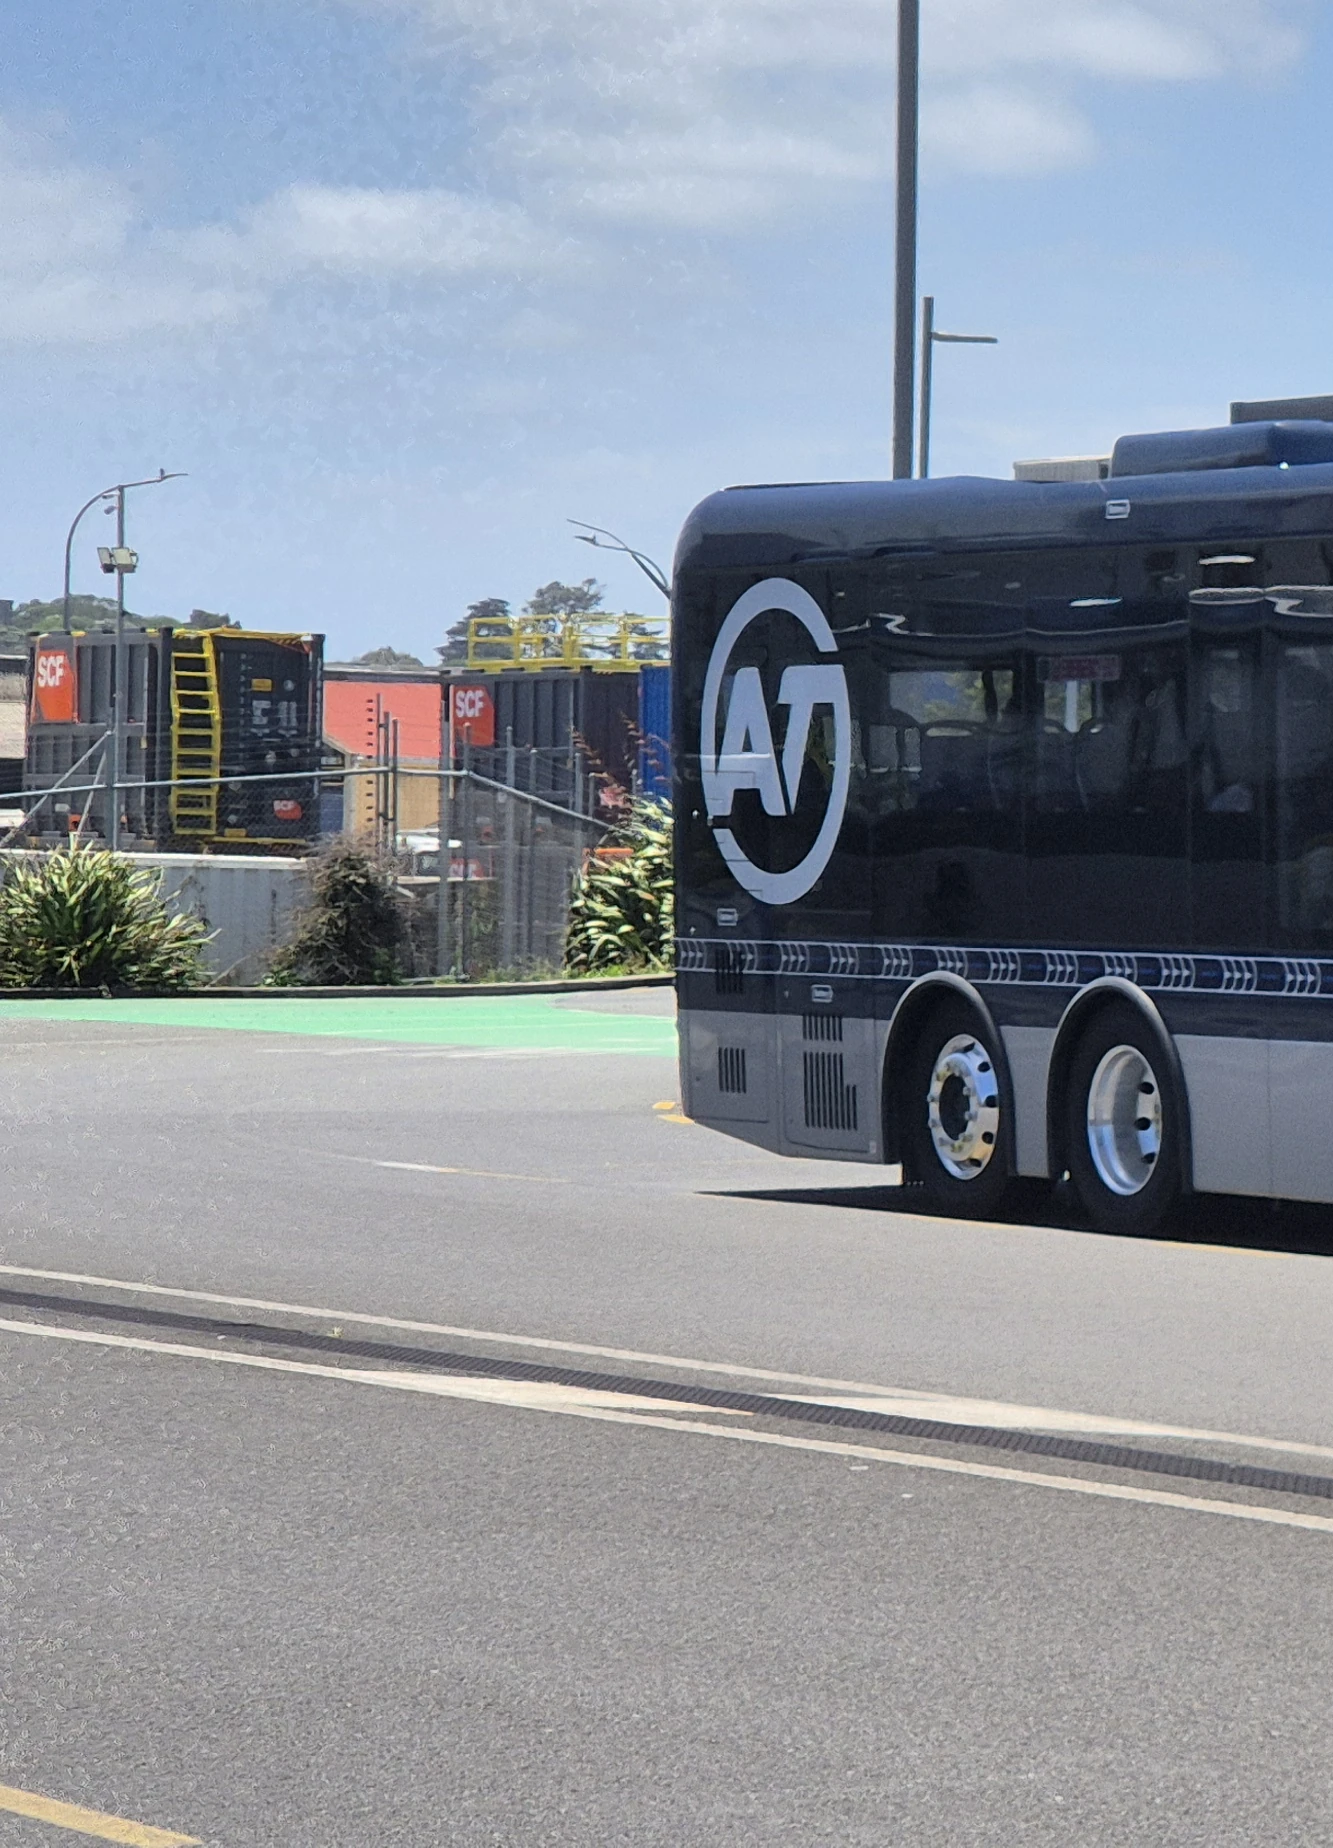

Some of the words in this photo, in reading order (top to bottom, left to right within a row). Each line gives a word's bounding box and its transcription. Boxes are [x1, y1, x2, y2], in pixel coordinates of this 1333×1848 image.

[38, 654, 65, 688] SCF
[456, 690, 484, 718] SCF
[702, 663, 850, 818] AT
